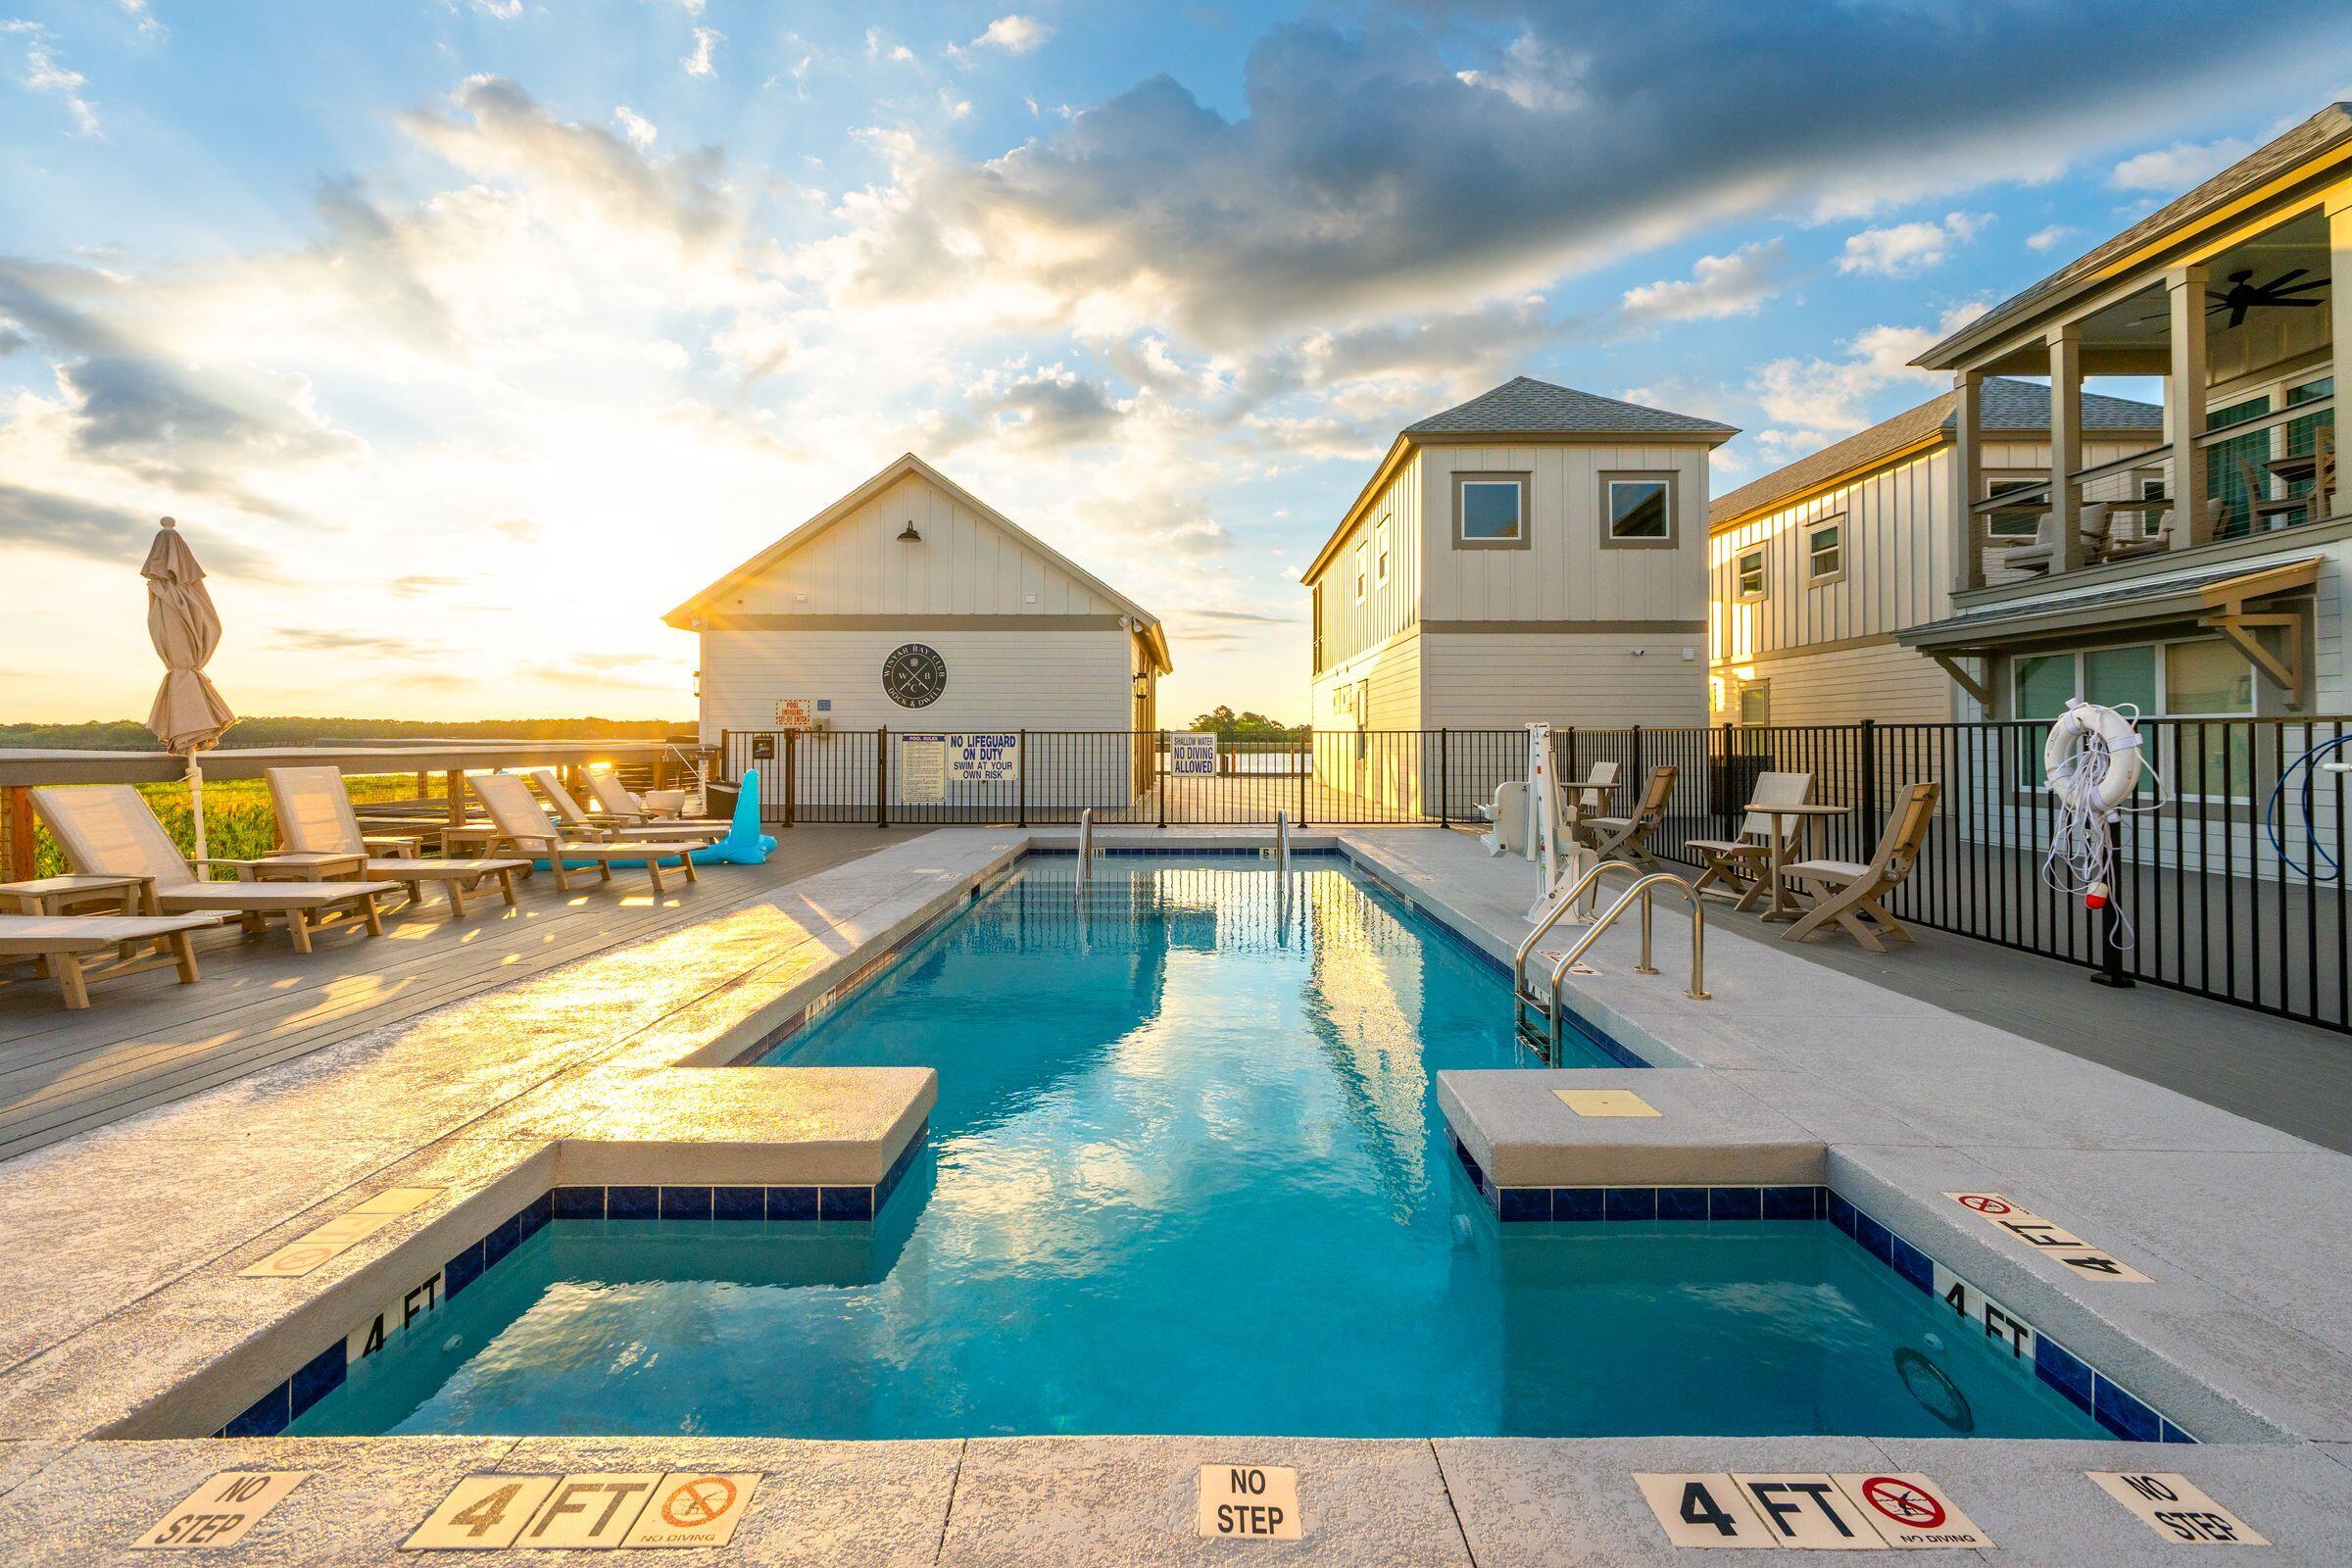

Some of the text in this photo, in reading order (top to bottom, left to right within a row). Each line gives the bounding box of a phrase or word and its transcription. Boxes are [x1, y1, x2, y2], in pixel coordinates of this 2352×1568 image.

[912, 645, 930, 655] BAY
[932, 655, 945, 678] CLUB
[887, 687, 907, 706] DOCK
[951, 736, 1016, 748] NO LIFEGUARD
[963, 749, 1003, 760] ON DUTY
[1174, 737, 1213, 746] SHALLOW WATER
[1174, 747, 1213, 760] NO DIVING
[1175, 760, 1212, 773] ALLOWED
[1997, 1220, 2123, 1275] 4 FT
[363, 1271, 441, 1359] 4 FT
[1944, 1282, 2029, 1359] 4 FT
[215, 1476, 271, 1502] NO
[1231, 1469, 1266, 1494] NO
[2120, 1475, 2179, 1501] NO
[448, 1483, 649, 1538] 4 FT
[1217, 1504, 1284, 1535] STEP
[1679, 1482, 1855, 1537] 4 FT
[154, 1513, 245, 1544] STEP
[666, 1534, 716, 1543] DIVING
[1926, 1534, 1976, 1543] DIVING
[2154, 1511, 2239, 1542] STEP
